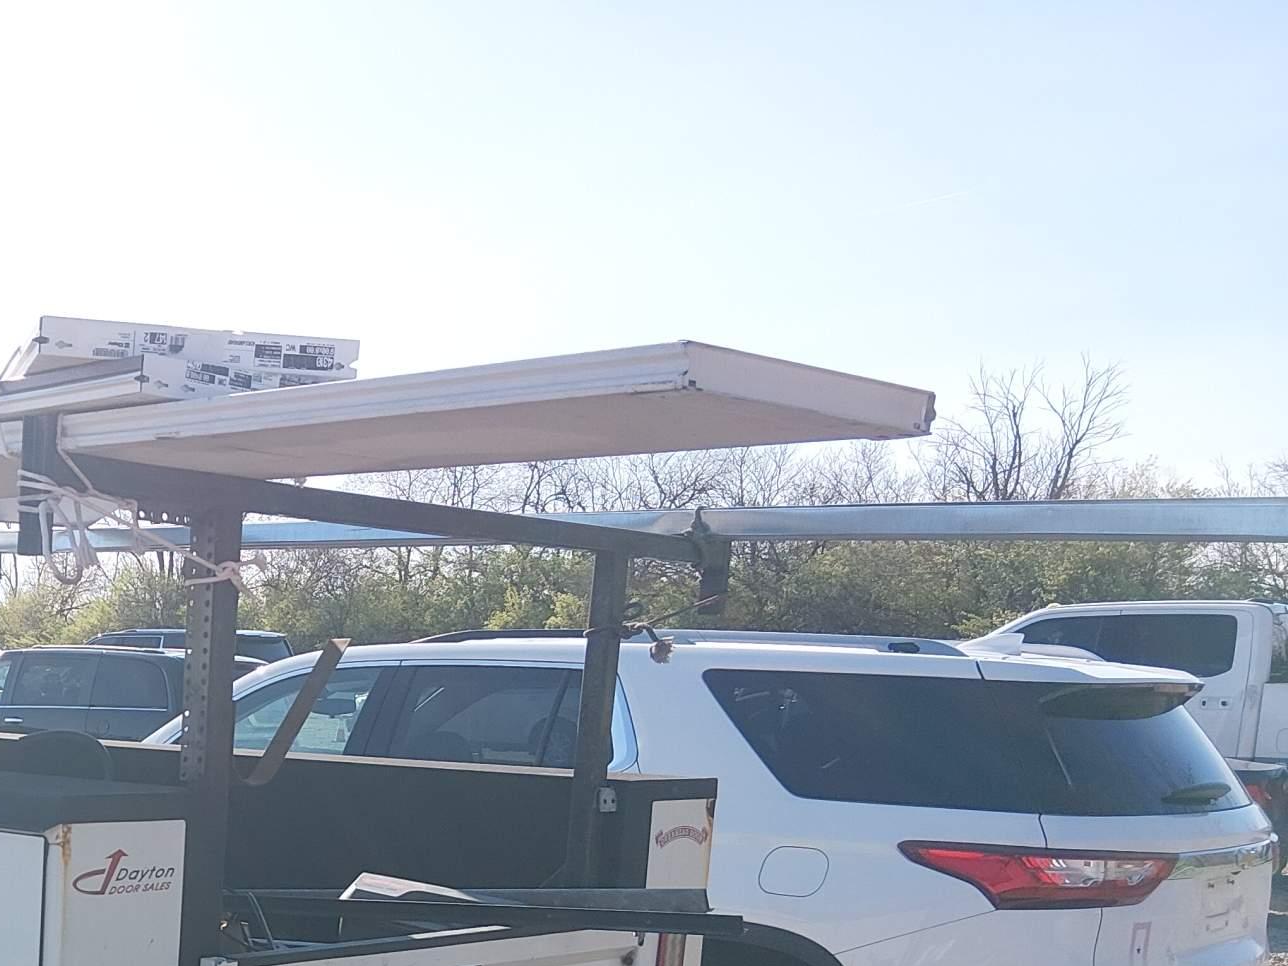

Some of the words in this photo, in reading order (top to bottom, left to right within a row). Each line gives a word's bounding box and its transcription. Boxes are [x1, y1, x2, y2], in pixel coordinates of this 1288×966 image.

[115, 866, 175, 882] Dayton
[108, 884, 139, 895] DOOR
[142, 881, 171, 892] SALES
